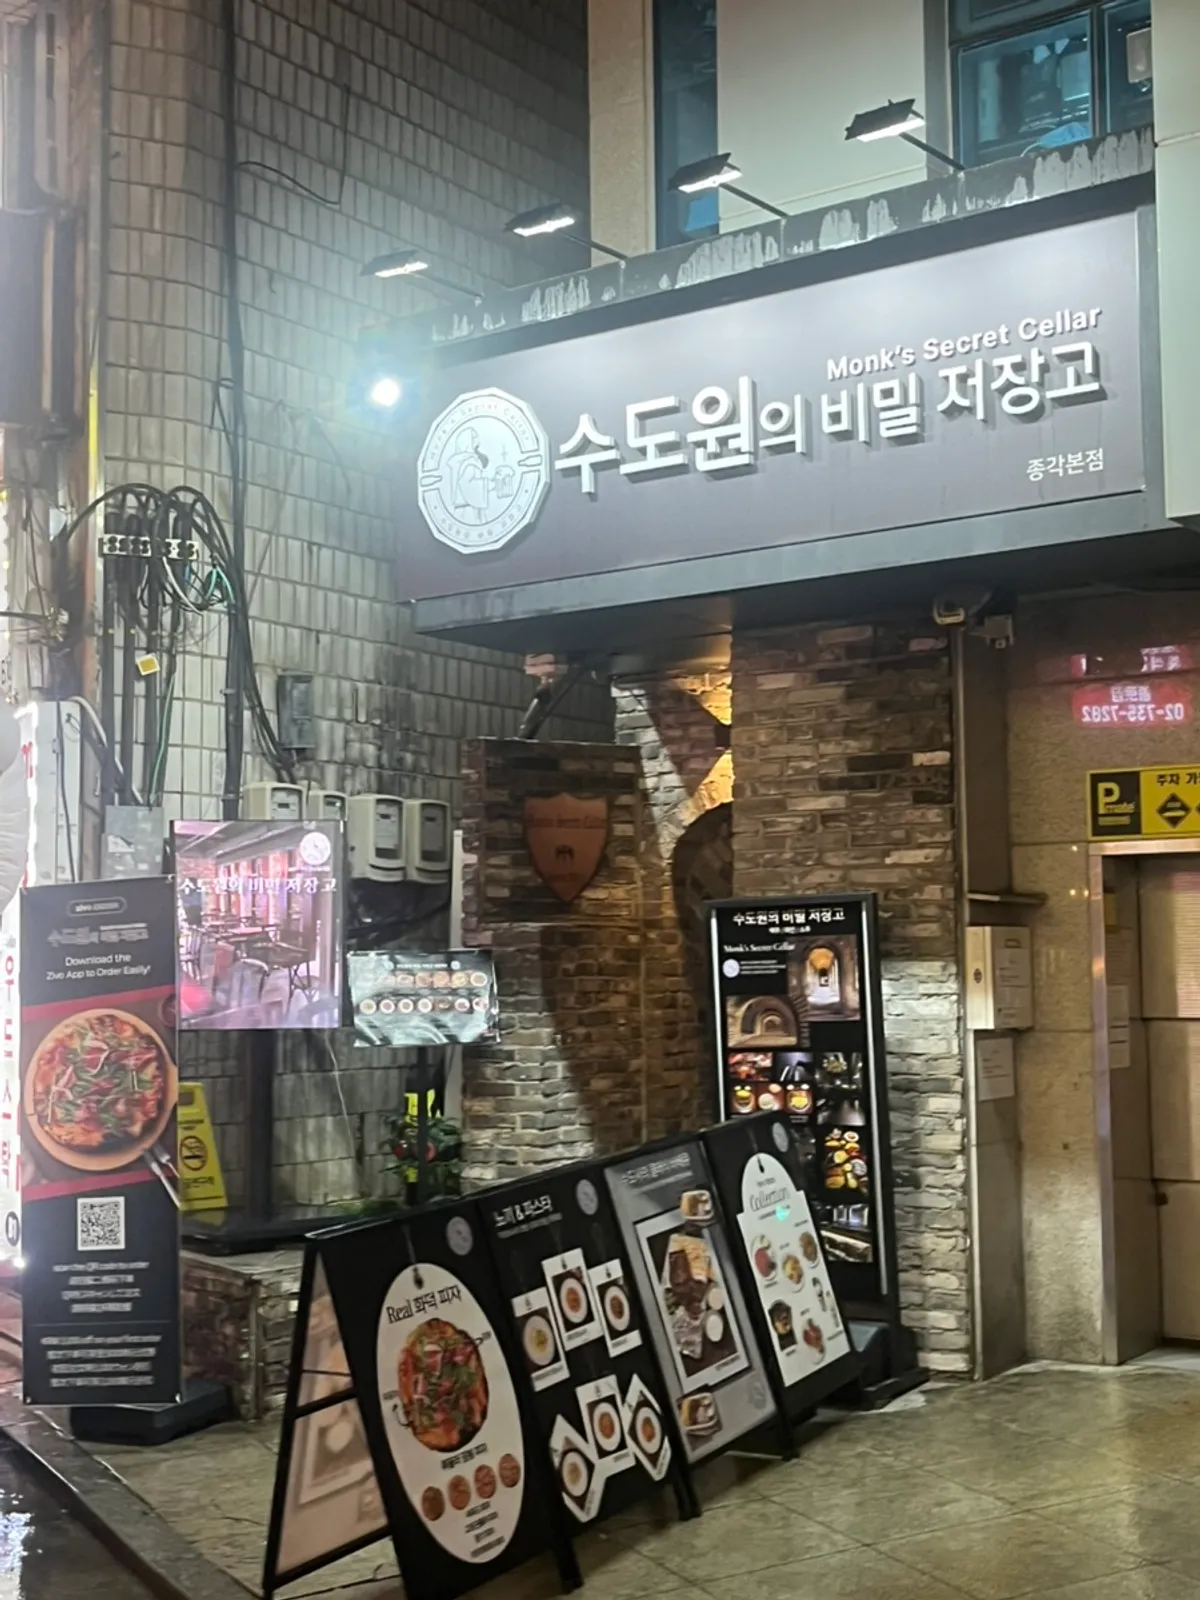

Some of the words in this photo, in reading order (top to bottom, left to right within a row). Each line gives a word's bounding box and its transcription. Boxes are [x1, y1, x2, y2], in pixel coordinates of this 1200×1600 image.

[827, 345, 916, 380] Monk's
[923, 324, 1011, 360] Secret
[1019, 307, 1102, 340] Cellar
[555, 376, 806, 493] 수도원의
[821, 372, 922, 443] 비밀
[937, 341, 1101, 420] 저장고
[1026, 448, 1104, 481] 종각본점
[1185, 771, 1200, 785] 가
[1098, 782, 1120, 813] P
[65, 954, 113, 967] Download
[115, 953, 132, 963] the
[66, 970, 85, 979] App
[86, 969, 95, 977] to
[96, 967, 121, 977] Order
[387, 1299, 414, 1324] Real
[412, 1292, 439, 1314] 화덕
[438, 1285, 462, 1305] 피자
